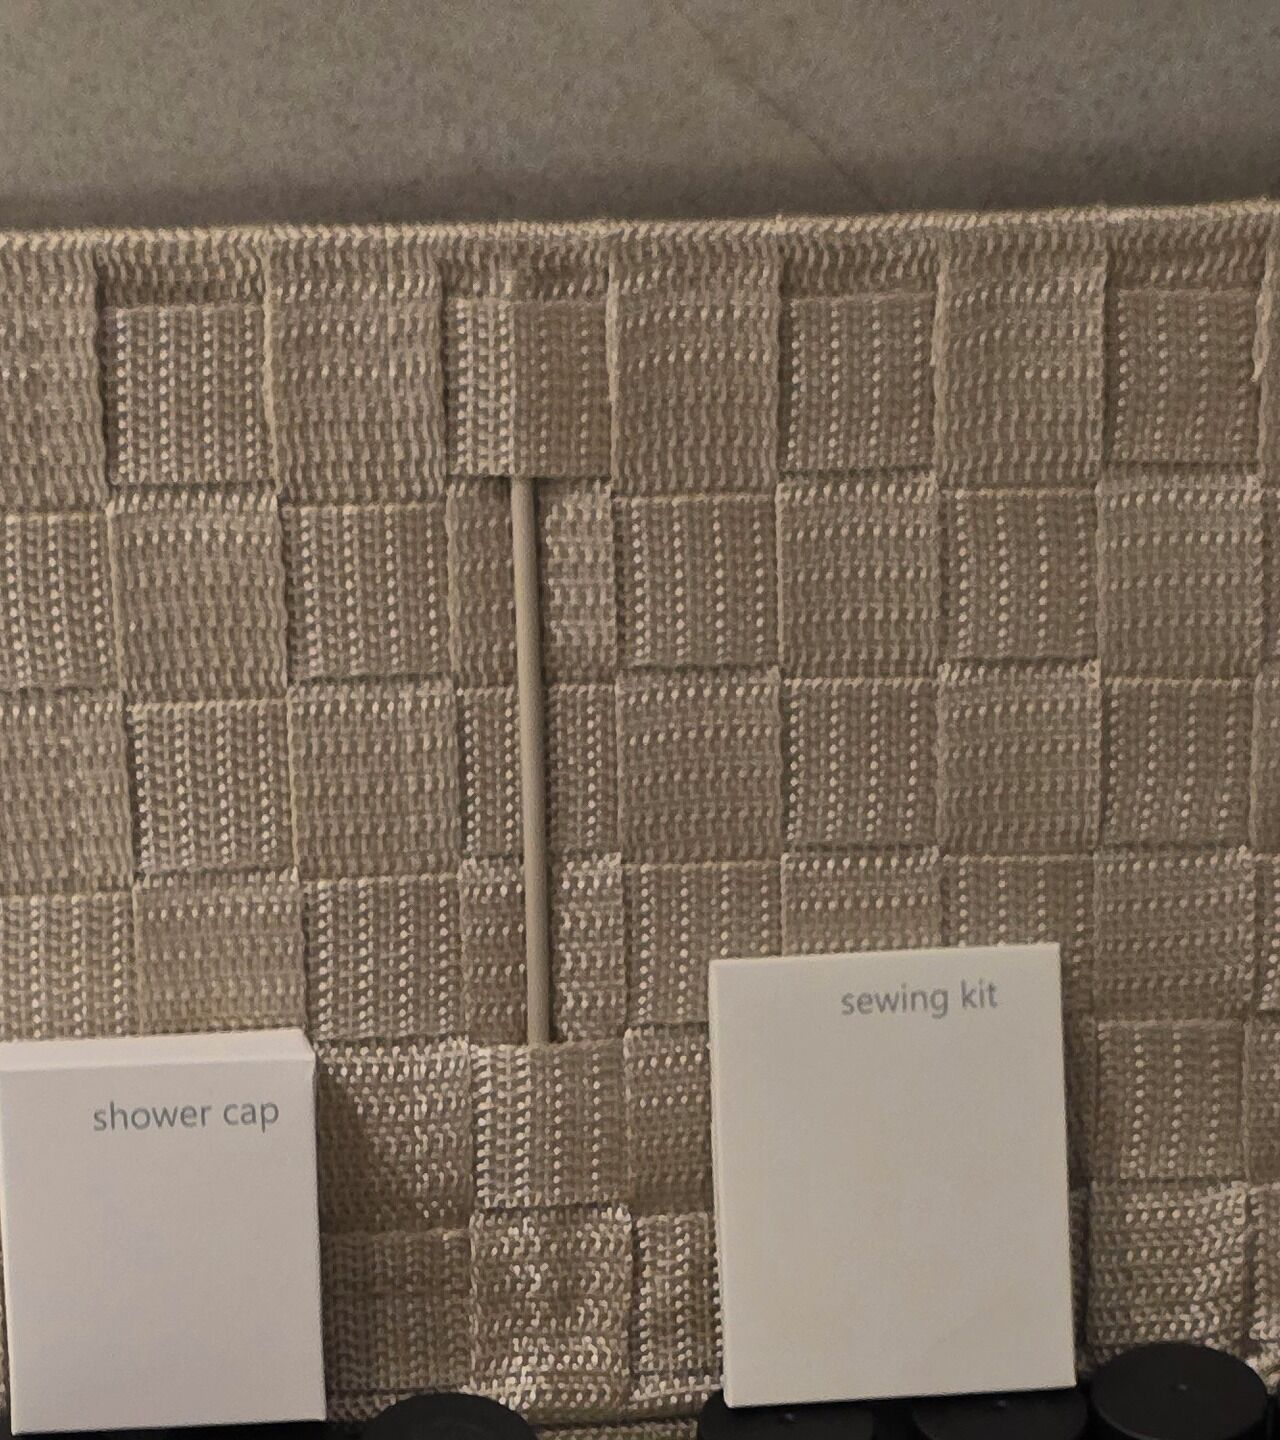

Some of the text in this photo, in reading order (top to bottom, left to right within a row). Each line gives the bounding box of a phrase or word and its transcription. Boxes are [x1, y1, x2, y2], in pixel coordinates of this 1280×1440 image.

[840, 977, 998, 1020] sewing kit
[93, 1101, 280, 1133] shower cap
